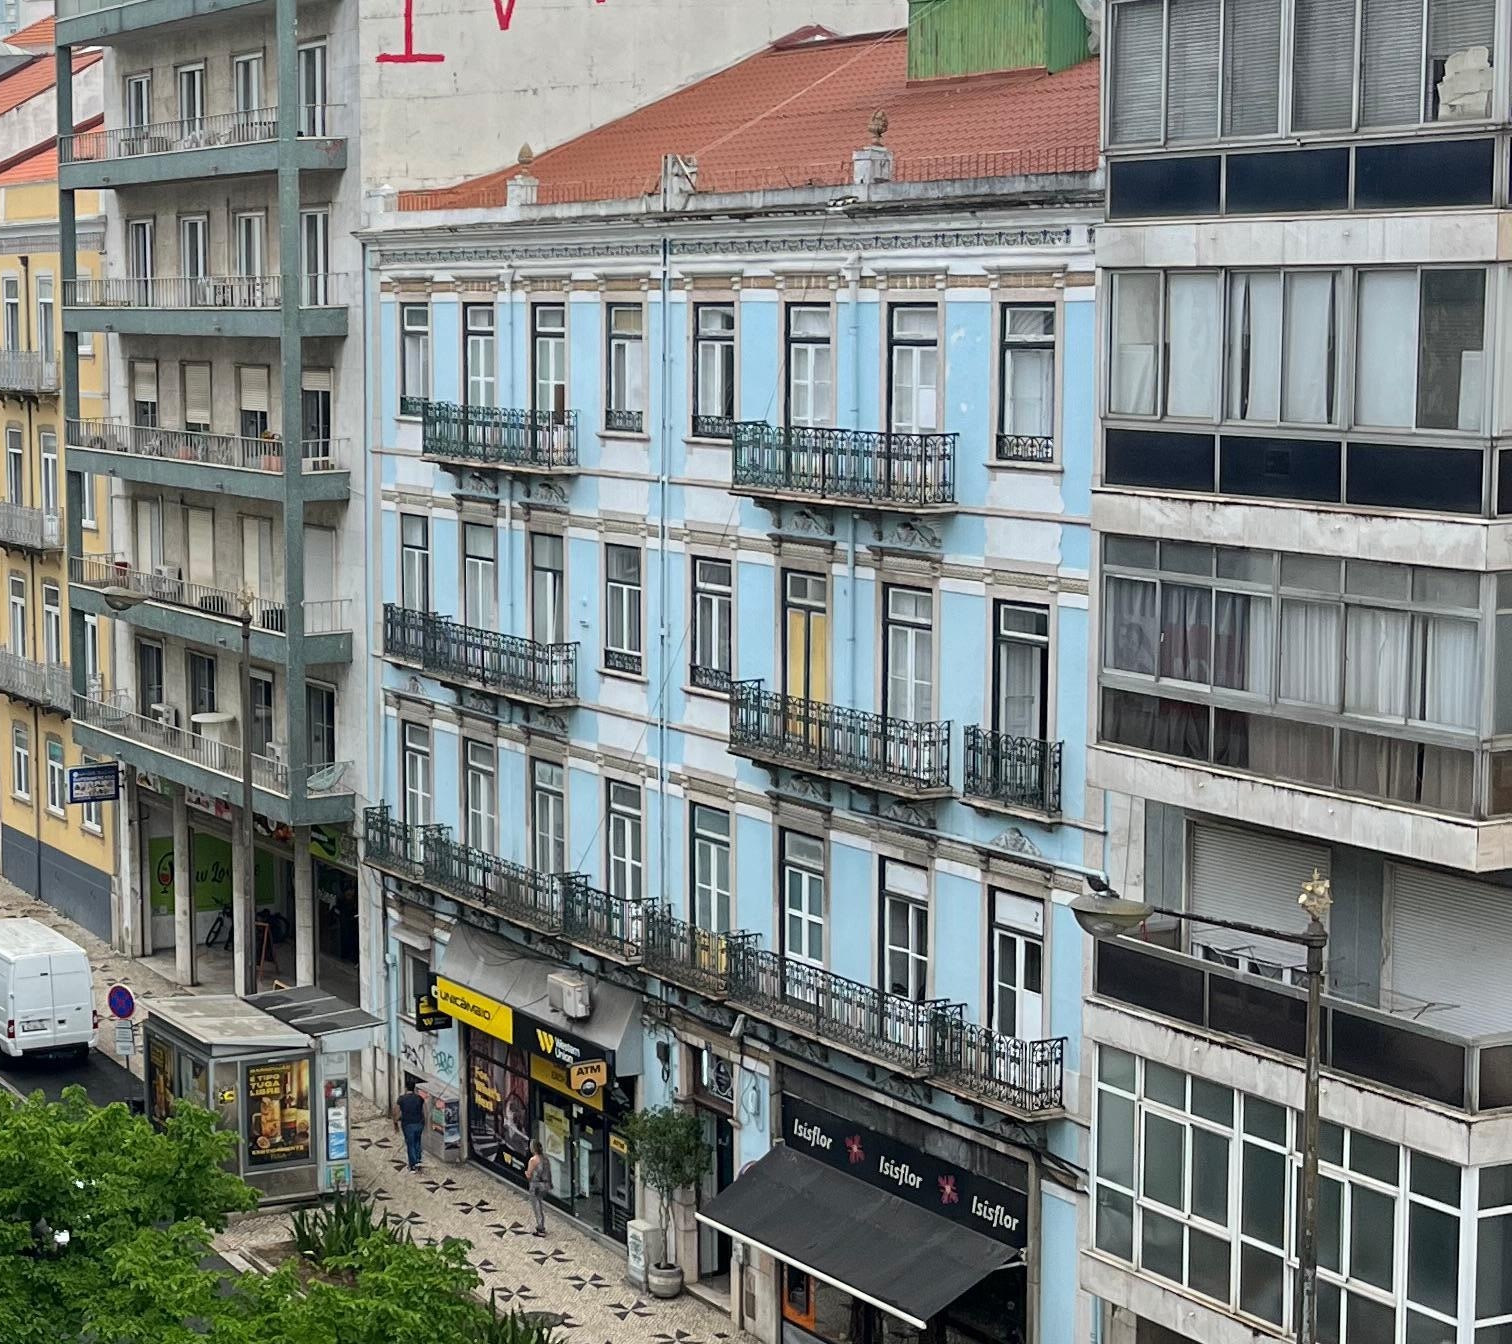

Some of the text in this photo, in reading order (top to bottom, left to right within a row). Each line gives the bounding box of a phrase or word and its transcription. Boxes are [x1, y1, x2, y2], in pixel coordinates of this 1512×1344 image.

[576, 1064, 601, 1076] ATM
[257, 1073, 281, 1082] TIPO
[249, 1080, 281, 1090] TUGA
[249, 1087, 281, 1097] LIBRE
[793, 1118, 1020, 1233] Isisflor Isisflor Isisflor
